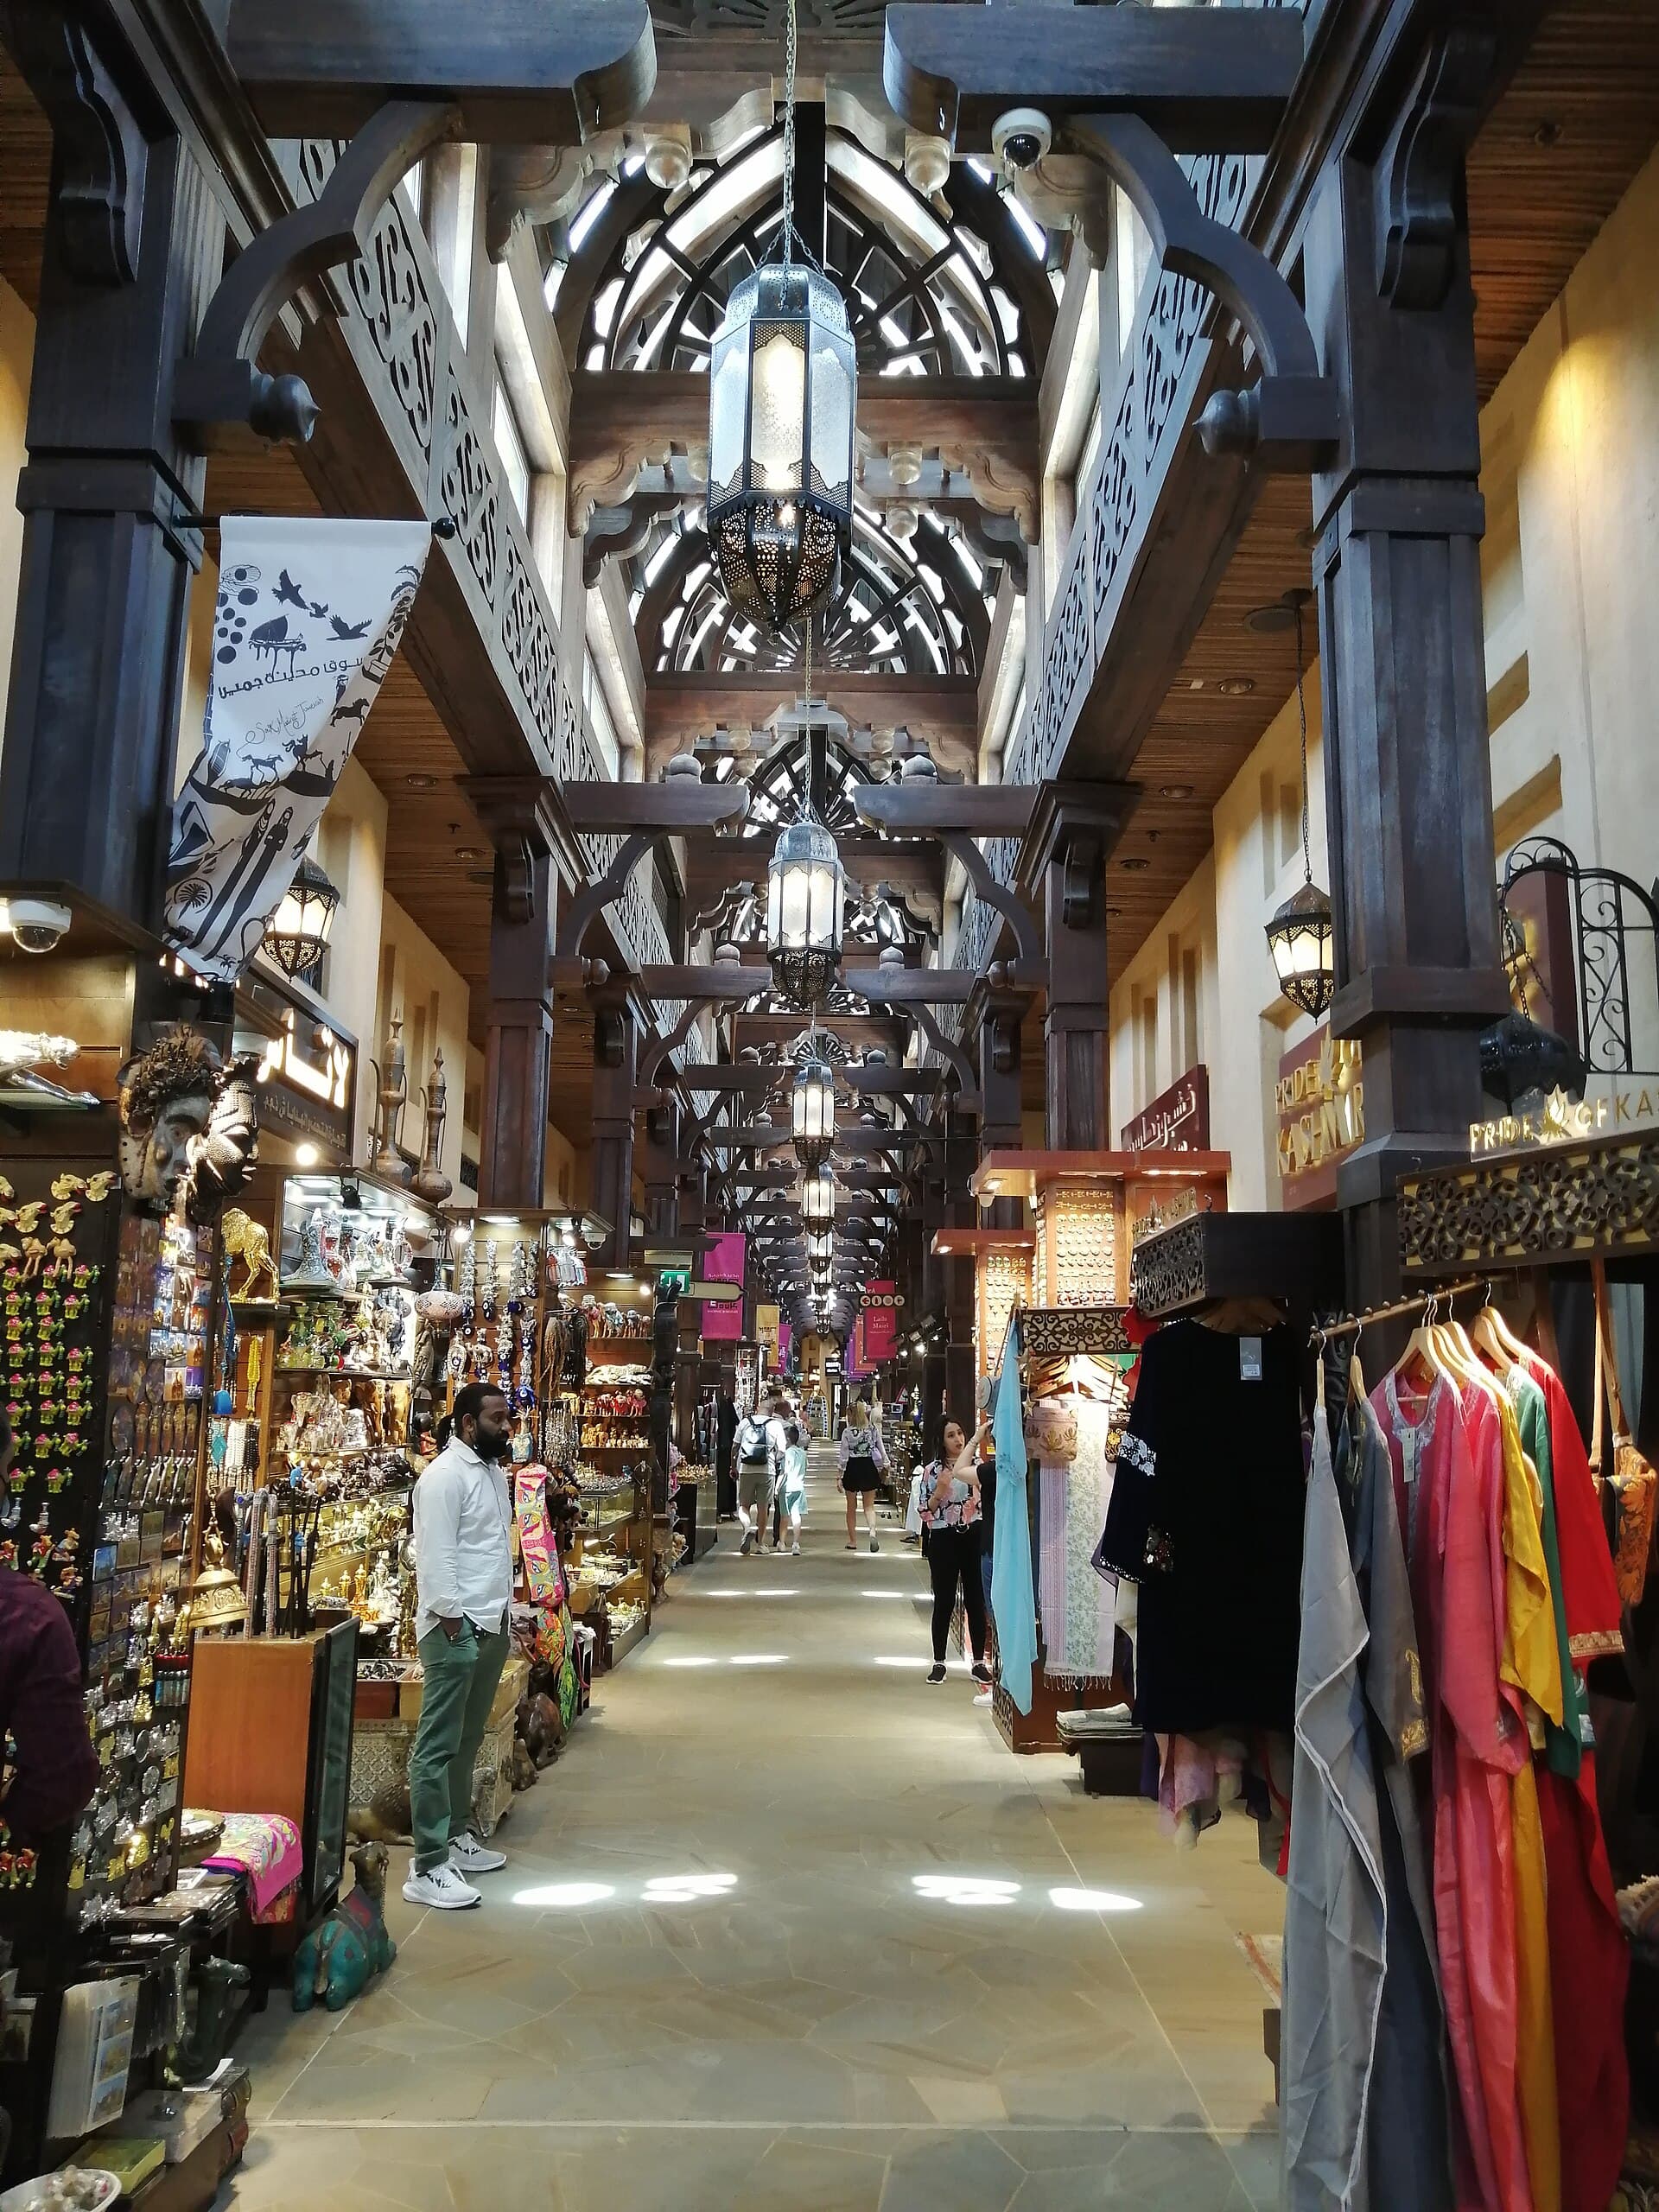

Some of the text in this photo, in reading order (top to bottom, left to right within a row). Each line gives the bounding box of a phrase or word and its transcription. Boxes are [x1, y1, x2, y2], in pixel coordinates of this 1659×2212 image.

[218, 677, 264, 700] جميرا
[264, 666, 320, 684] مدينة
[1275, 1059, 1322, 1116] PRIDE
[1276, 1082, 1365, 1178] KASHMIR
[1470, 1090, 1659, 1154] PRIDE OF KA
